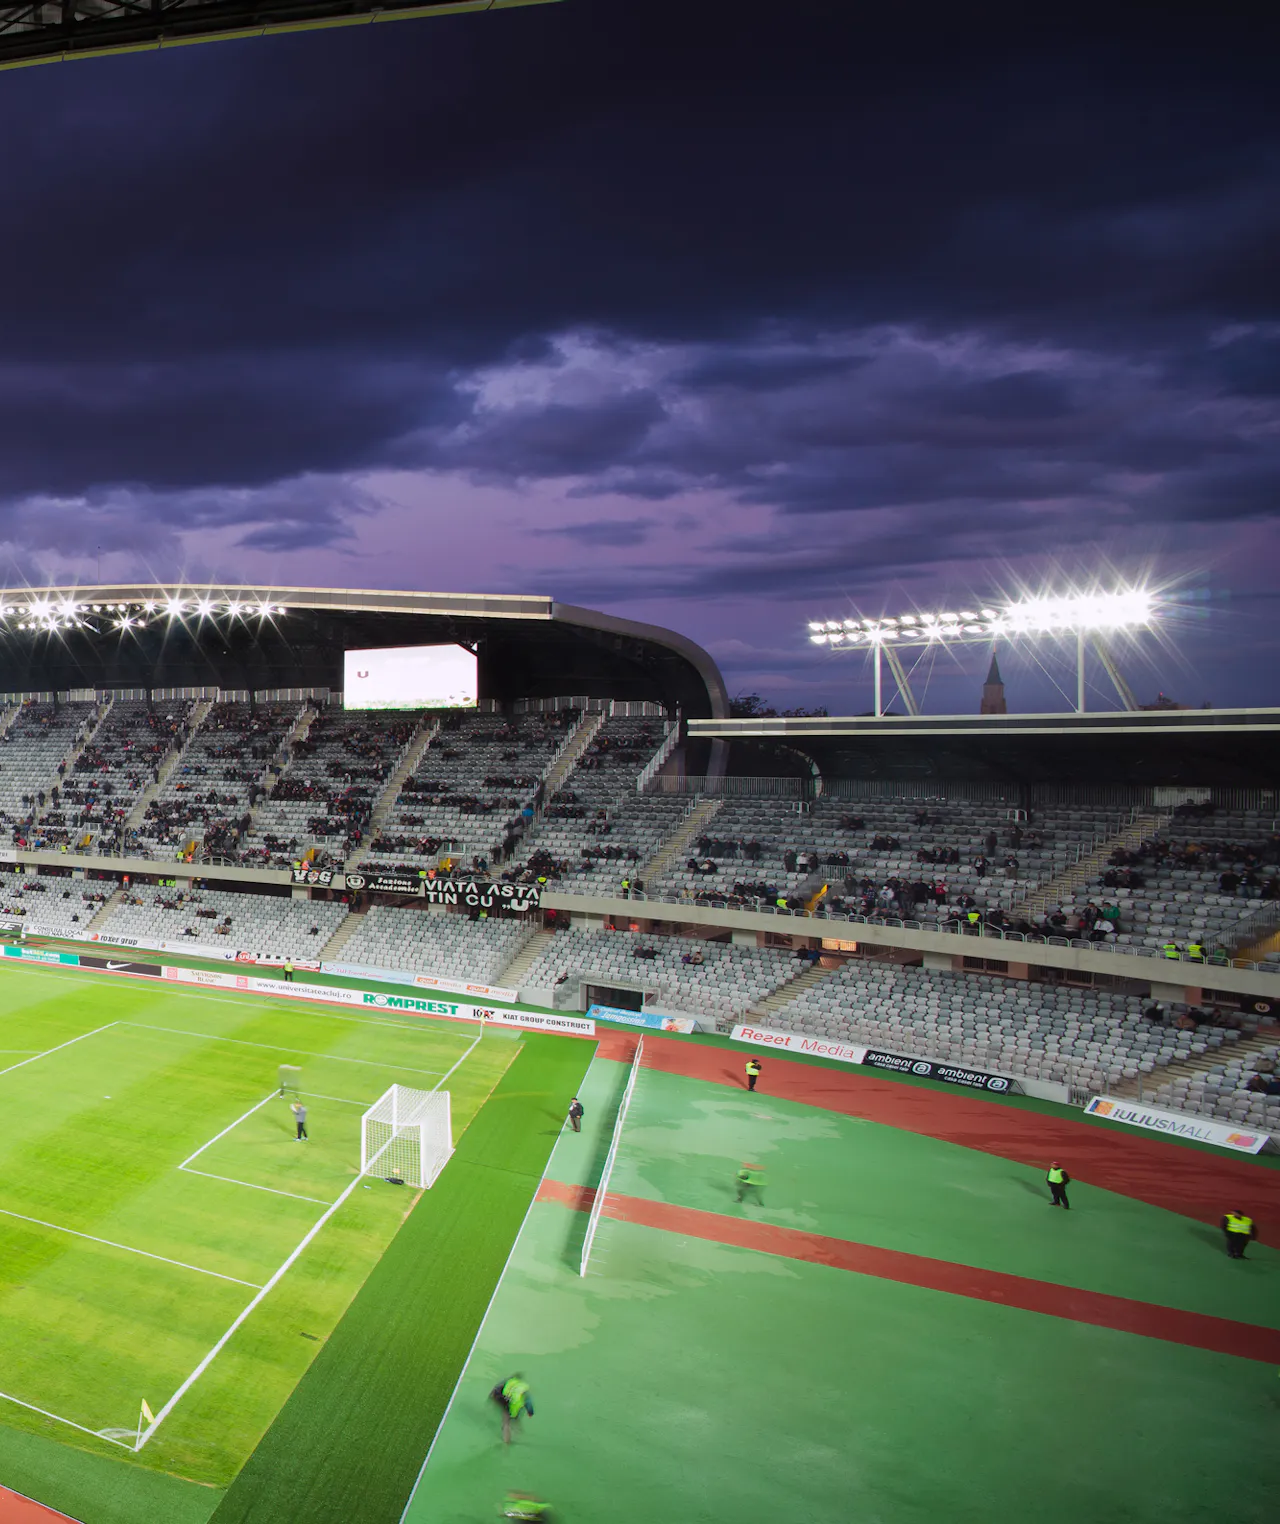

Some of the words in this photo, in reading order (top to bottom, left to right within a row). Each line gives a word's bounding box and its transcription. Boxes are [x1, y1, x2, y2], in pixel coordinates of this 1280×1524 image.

[426, 891, 458, 905] TIN
[465, 894, 493, 908] CU
[487, 884, 540, 900] ASTA
[100, 935, 119, 943] roxer
[121, 937, 138, 946] grup
[256, 981, 352, 1000] www.universitateacluj.ro
[363, 993, 459, 1015] ROMPREST
[520, 1015, 544, 1024] GROUP
[546, 1017, 590, 1030] CONSTRUCT
[740, 1028, 792, 1047] Reset
[801, 1039, 855, 1059] Media
[868, 1053, 913, 1068] ambient
[937, 1067, 987, 1083] ambient
